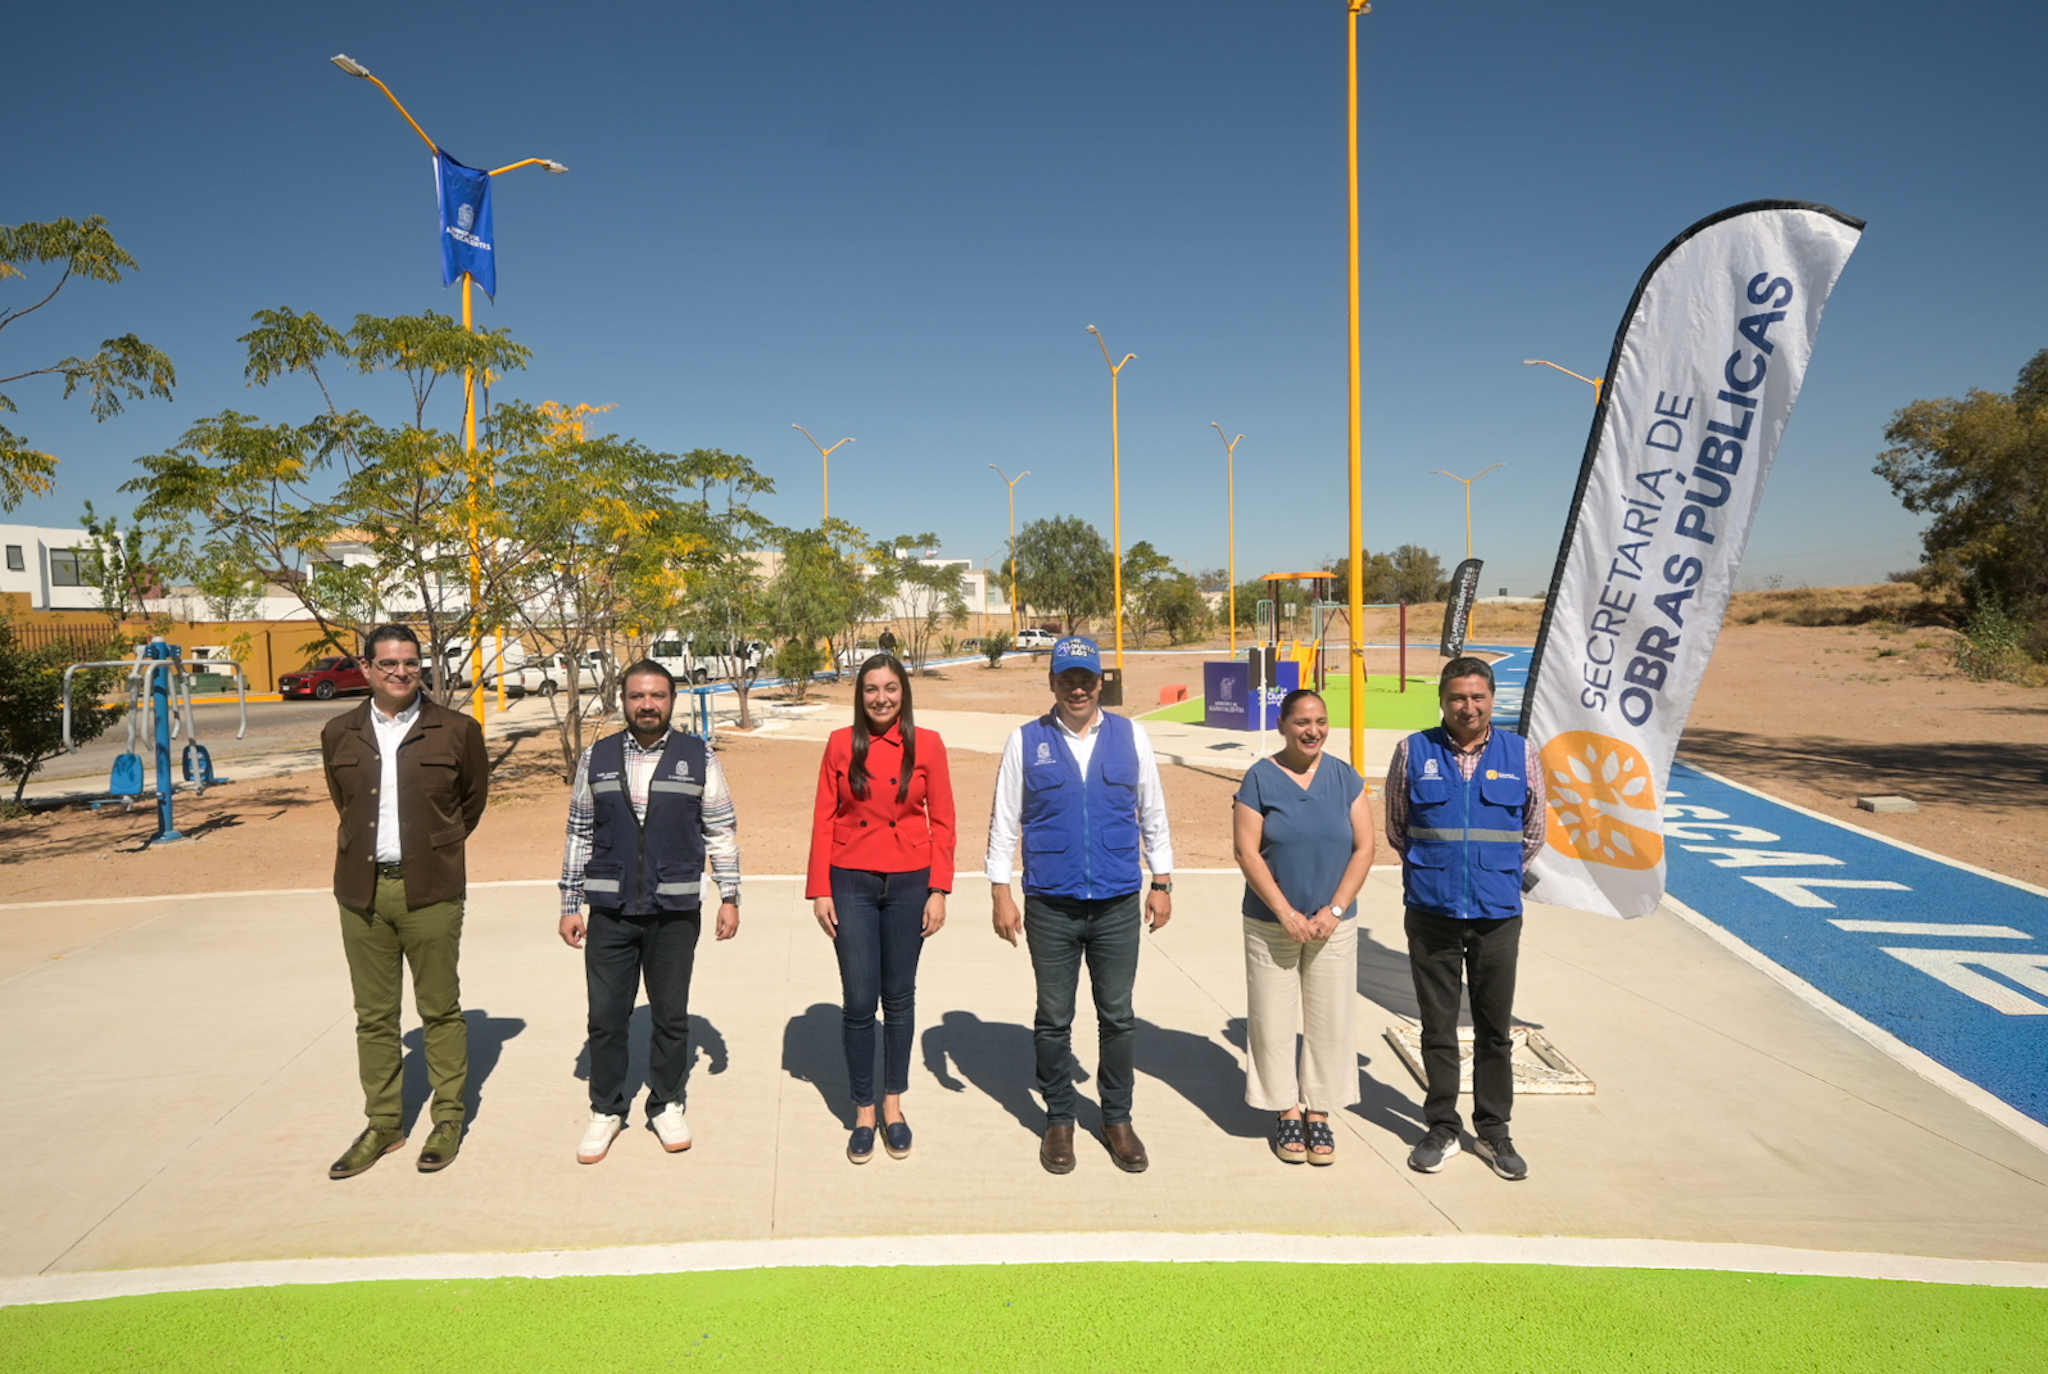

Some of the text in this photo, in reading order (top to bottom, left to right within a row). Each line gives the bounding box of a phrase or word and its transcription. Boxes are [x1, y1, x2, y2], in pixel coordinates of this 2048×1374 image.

[1581, 390, 1694, 712] SECRETARÍA DE
[1619, 271, 1794, 727] OBRAS PÚBLICAS
